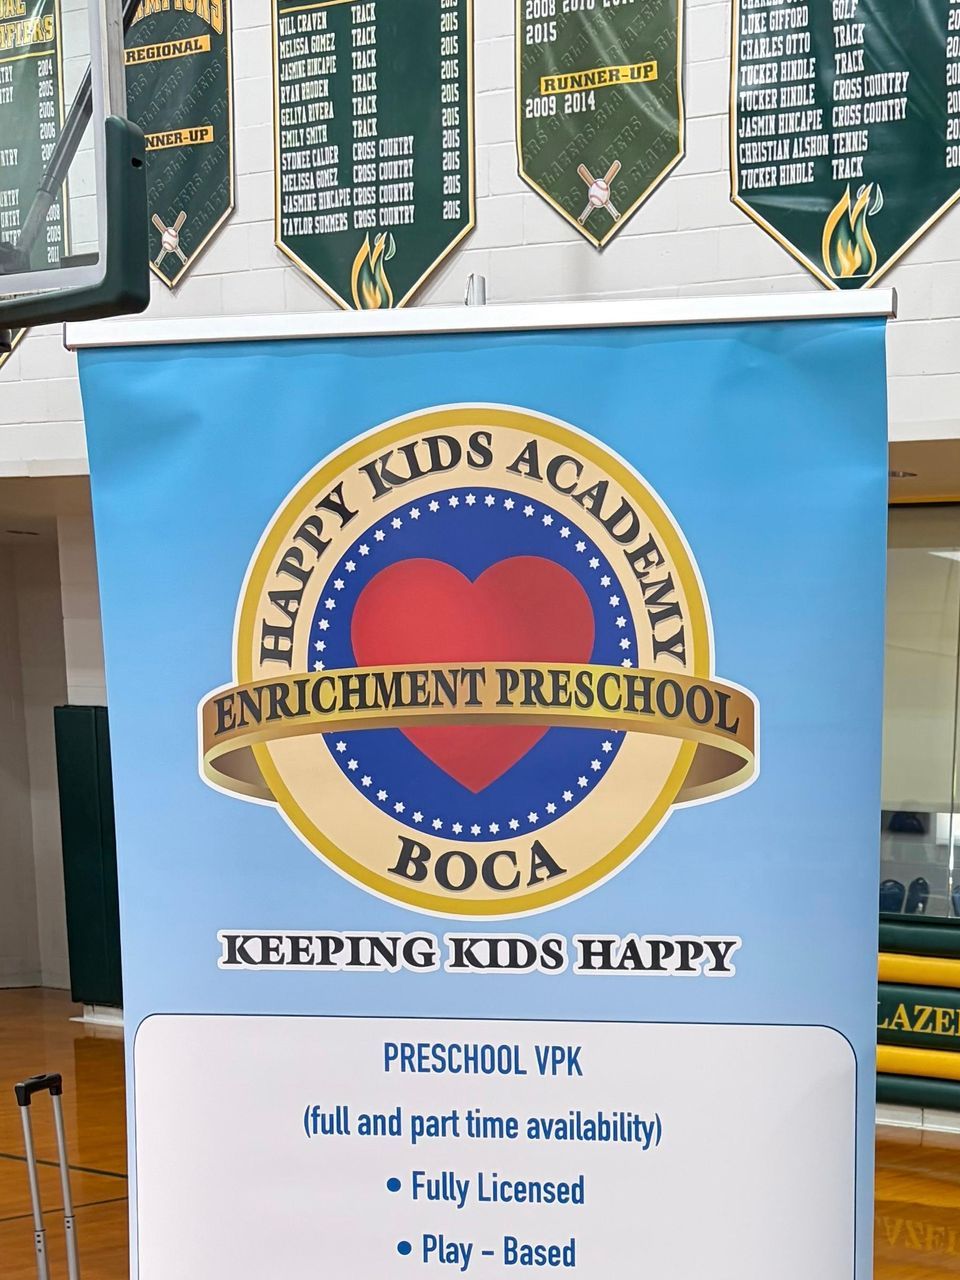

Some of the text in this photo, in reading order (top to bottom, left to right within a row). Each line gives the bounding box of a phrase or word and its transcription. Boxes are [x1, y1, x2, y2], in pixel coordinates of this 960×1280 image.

[280, 3, 375, 36] WILL CRAVEN TRACK
[526, 0, 555, 19] 2008
[741, 0, 858, 35] LUKE GIFFORD GOLF
[0, 14, 54, 50] IFIERS
[280, 12, 458, 59] MELISSA GOMEZ TRACK 2015
[526, 21, 557, 45] 2015
[741, 36, 783, 60] CHARLES
[786, 32, 810, 55] OTTO
[833, 24, 865, 48] TRACK
[126, 39, 202, 63] REGIONAL
[352, 49, 376, 70] TRACK
[441, 36, 458, 55] 2015
[740, 63, 777, 86] TUCKER
[780, 58, 816, 81] HINDLE
[835, 50, 864, 74] TRACK
[281, 83, 300, 103] RYAN
[352, 72, 377, 92] TRACK
[441, 59, 458, 79] 2015
[544, 64, 654, 92] RUNNER-UP
[740, 89, 777, 112] TUCKER
[780, 84, 815, 107] HINDLE
[833, 77, 862, 101] CROSS
[864, 72, 909, 97] COUNTRY
[308, 101, 334, 122] RIVERA
[352, 95, 377, 115] TRACK
[441, 83, 459, 103] 2015
[526, 90, 596, 119] 2009 2014
[739, 115, 776, 138] JASMIN
[778, 109, 823, 134] HINCAPIE
[832, 103, 861, 127] CROSS
[864, 98, 907, 124] COUNTRY
[145, 129, 209, 148] NNER-UP
[282, 107, 459, 148] EMILY SMITH TRACK 2015
[282, 129, 460, 171] SYDNEE CALDER CROSS COUNTRY 2015
[740, 139, 790, 164] CHRISTIAN
[793, 135, 829, 159] ALSHON
[832, 131, 868, 155] TENNIS
[283, 151, 460, 192] MELISSA GOMEZ CROSS COUNTRY 2015
[741, 167, 777, 190] TUCKER
[780, 162, 814, 184] HINDLE
[832, 156, 863, 180] TRACK
[283, 175, 460, 213] JASMINE HINCAPIE CROSS COUNTRY 2015
[283, 201, 460, 236] TAYLOR SUMMERS CROSS COUNTRY 2015
[260, 430, 688, 670] HAPPY KIDS ACADEMY
[214, 666, 740, 736] ENRICHMENT PRESCHOOL
[388, 833, 567, 892] BOCA
[221, 934, 737, 973] KEEPING KIDS HAPPY
[383, 1042, 584, 1077] PRESCHOOL VPK
[303, 1105, 663, 1150] (full and part time availability)
[411, 1171, 584, 1208] Fully Licensed
[422, 1236, 472, 1272] Play
[503, 1236, 576, 1267] Based
